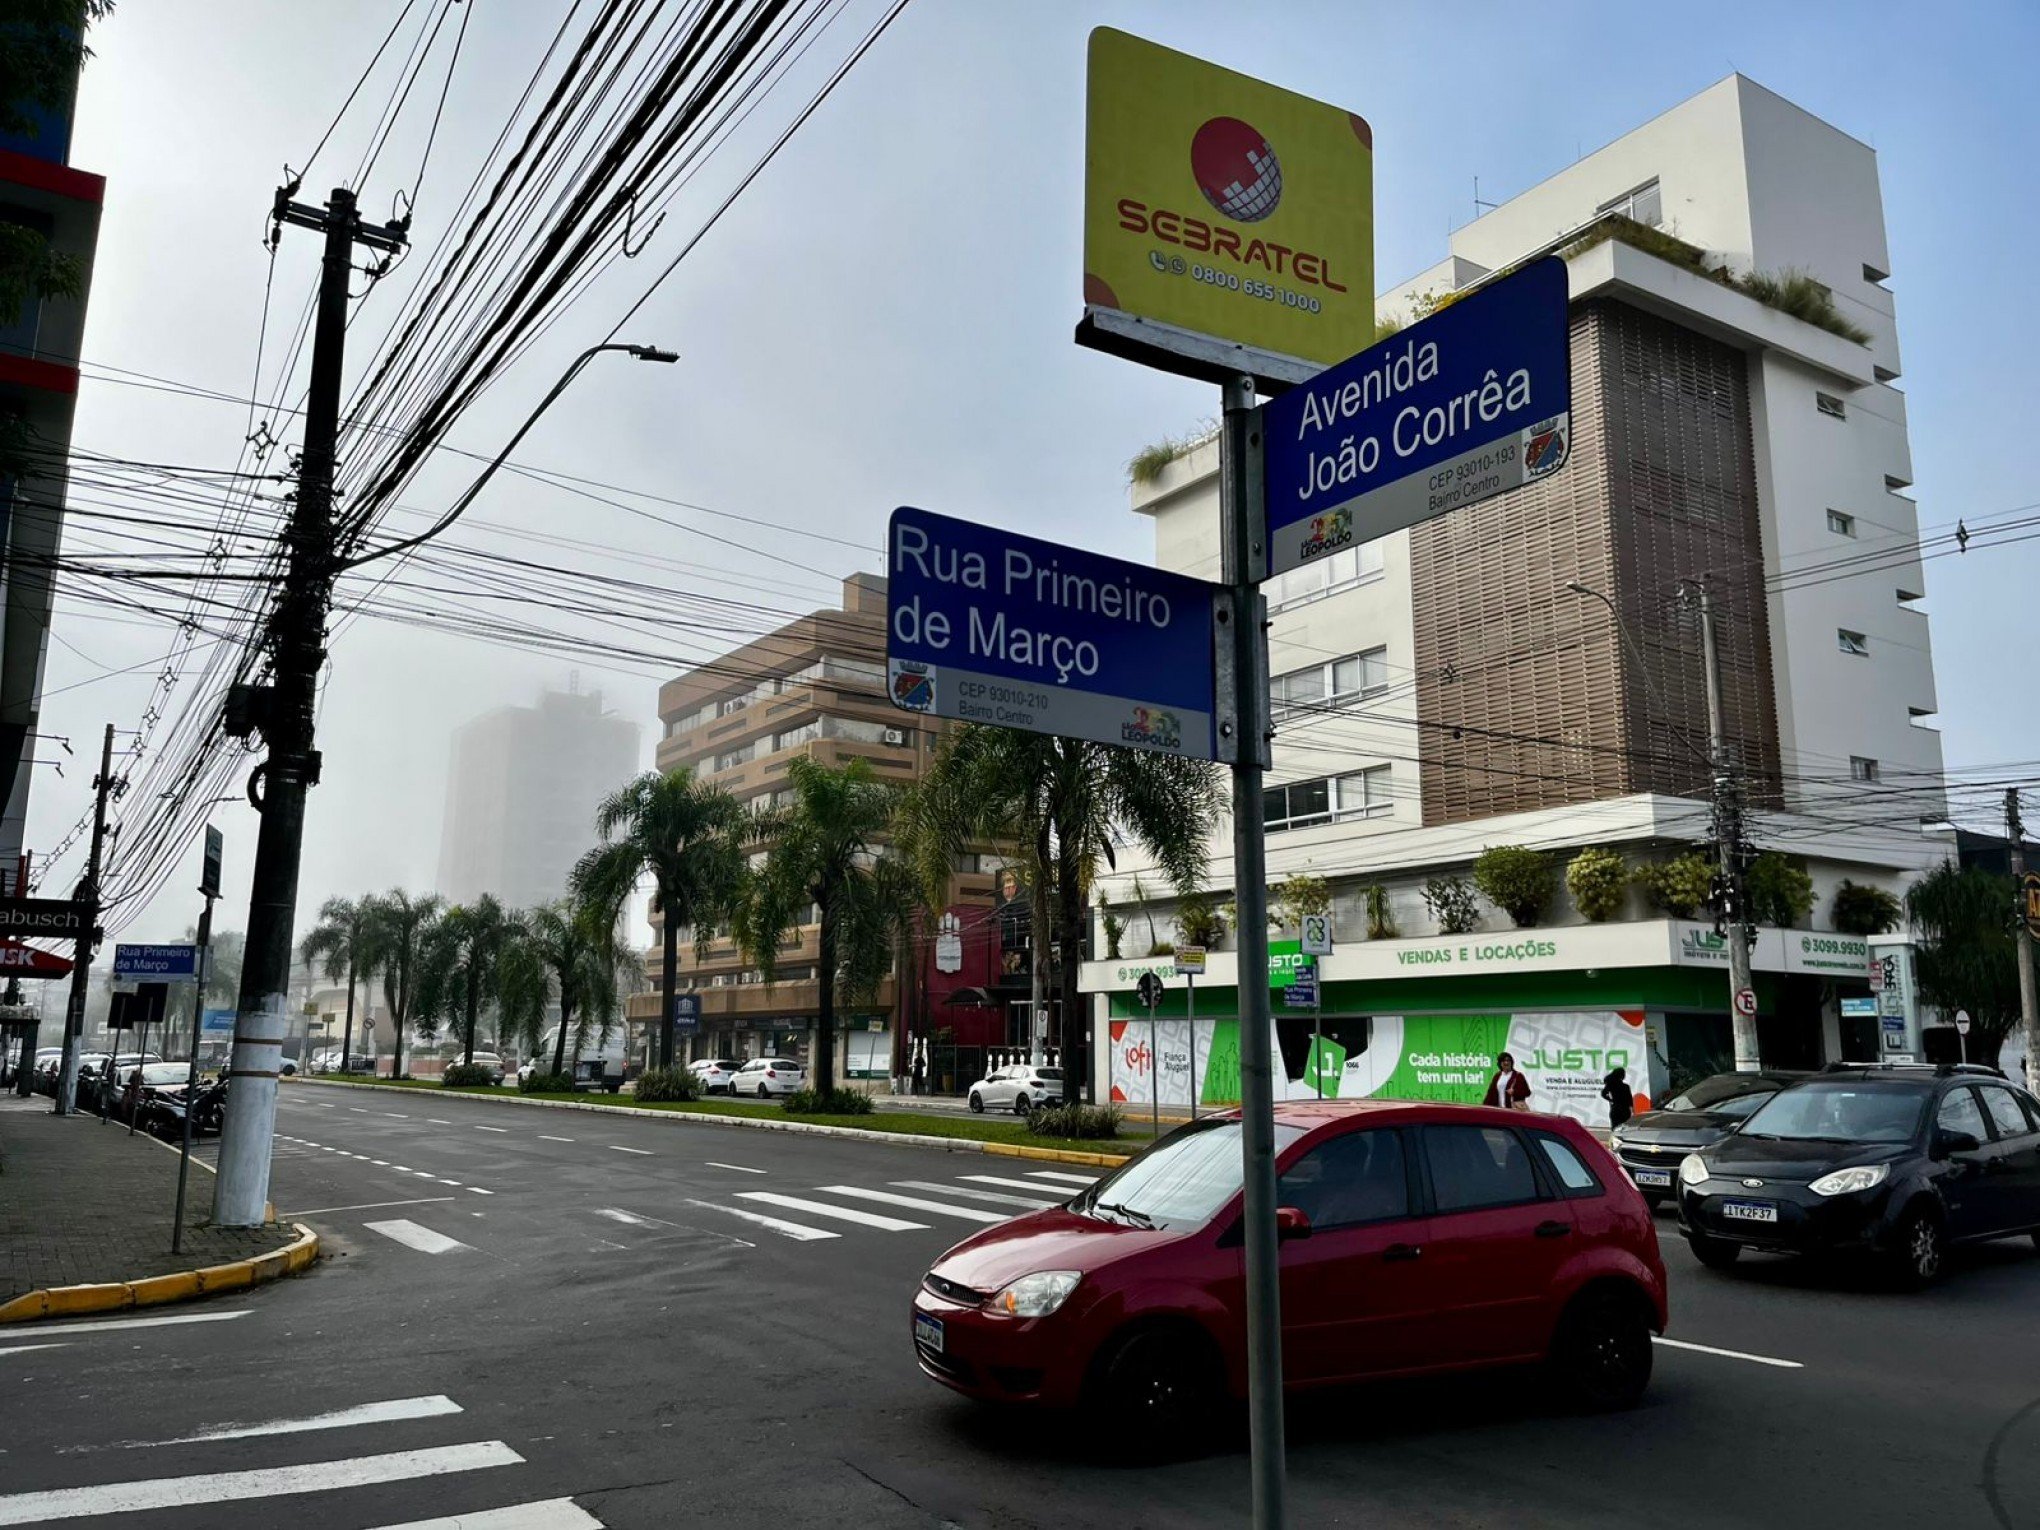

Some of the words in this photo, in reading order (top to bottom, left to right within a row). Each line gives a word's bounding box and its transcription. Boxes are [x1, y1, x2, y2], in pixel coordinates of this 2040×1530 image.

[1117, 199, 1347, 293] SEBRATEL
[1191, 263, 1239, 290] 0800
[1243, 278, 1274, 300] 655
[1278, 287, 1322, 314] 1000
[1297, 339, 1439, 441] Avenida
[1299, 434, 1381, 501] João
[1392, 368, 1532, 458] Corrêa
[1428, 470, 1454, 491] CEP
[1455, 445, 1516, 481] 93010-193
[1428, 488, 1461, 511] Bairro
[1463, 475, 1500, 498] Centro
[1300, 530, 1353, 560] LEOPOLDO
[896, 523, 987, 591] Rua
[1004, 548, 1171, 628] Primeiro
[894, 595, 951, 650] de
[968, 606, 1099, 684] Março
[958, 681, 987, 699] CEP
[989, 686, 1049, 710] 93010-210
[958, 700, 993, 720] Bairro
[996, 705, 1033, 725] Centro
[1121, 729, 1180, 748] LEOPOLDO
[117, 945, 140, 957] Rua
[144, 946, 191, 958] Primeiro
[1682, 929, 1725, 949] JUS
[1812, 938, 1866, 956] 3099.9930
[115, 958, 131, 970] de
[133, 959, 169, 972] Março
[1397, 949, 1452, 965] VENDAS
[1459, 948, 1468, 961] E
[1475, 940, 1556, 961] LOCAÇÕES
[1163, 1051, 1187, 1063] Fiança
[1163, 1061, 1190, 1073] Aluguel
[1408, 1052, 1441, 1068] Cada
[1442, 1051, 1491, 1068] história
[1521, 1049, 1629, 1071] JUSTO
[1417, 1070, 1440, 1085] tem
[1441, 1072, 1460, 1084] um
[1462, 1069, 1484, 1085] lar!
